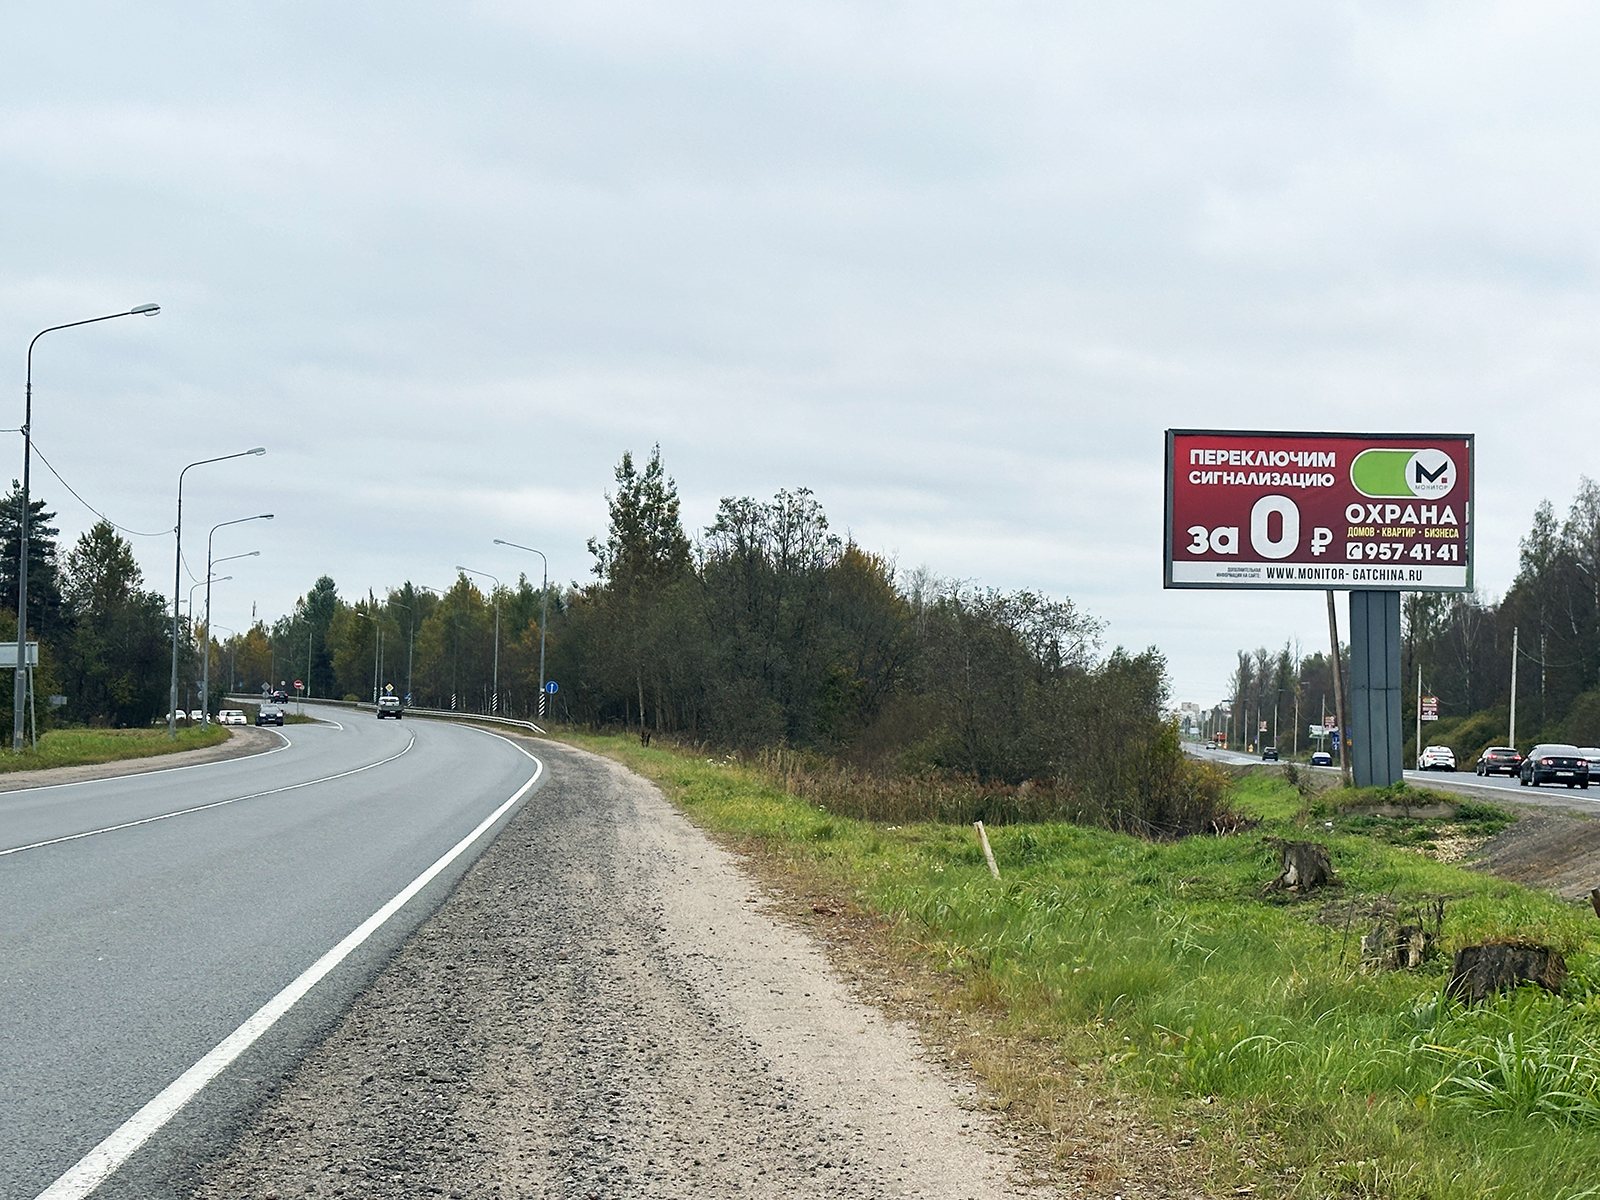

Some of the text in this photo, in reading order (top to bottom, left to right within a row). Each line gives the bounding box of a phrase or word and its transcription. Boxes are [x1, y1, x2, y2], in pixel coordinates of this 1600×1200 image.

[1190, 449, 1336, 468] ПЕРЕКЛЮЧИМ
[1188, 471, 1335, 488] СИГНАЛИЗАЦИЮ
[1345, 503, 1458, 525] ОХРАНА
[1250, 494, 1300, 559] 0
[1347, 526, 1460, 538] ДОМОВ КВАРТИР БИЗНЕСА
